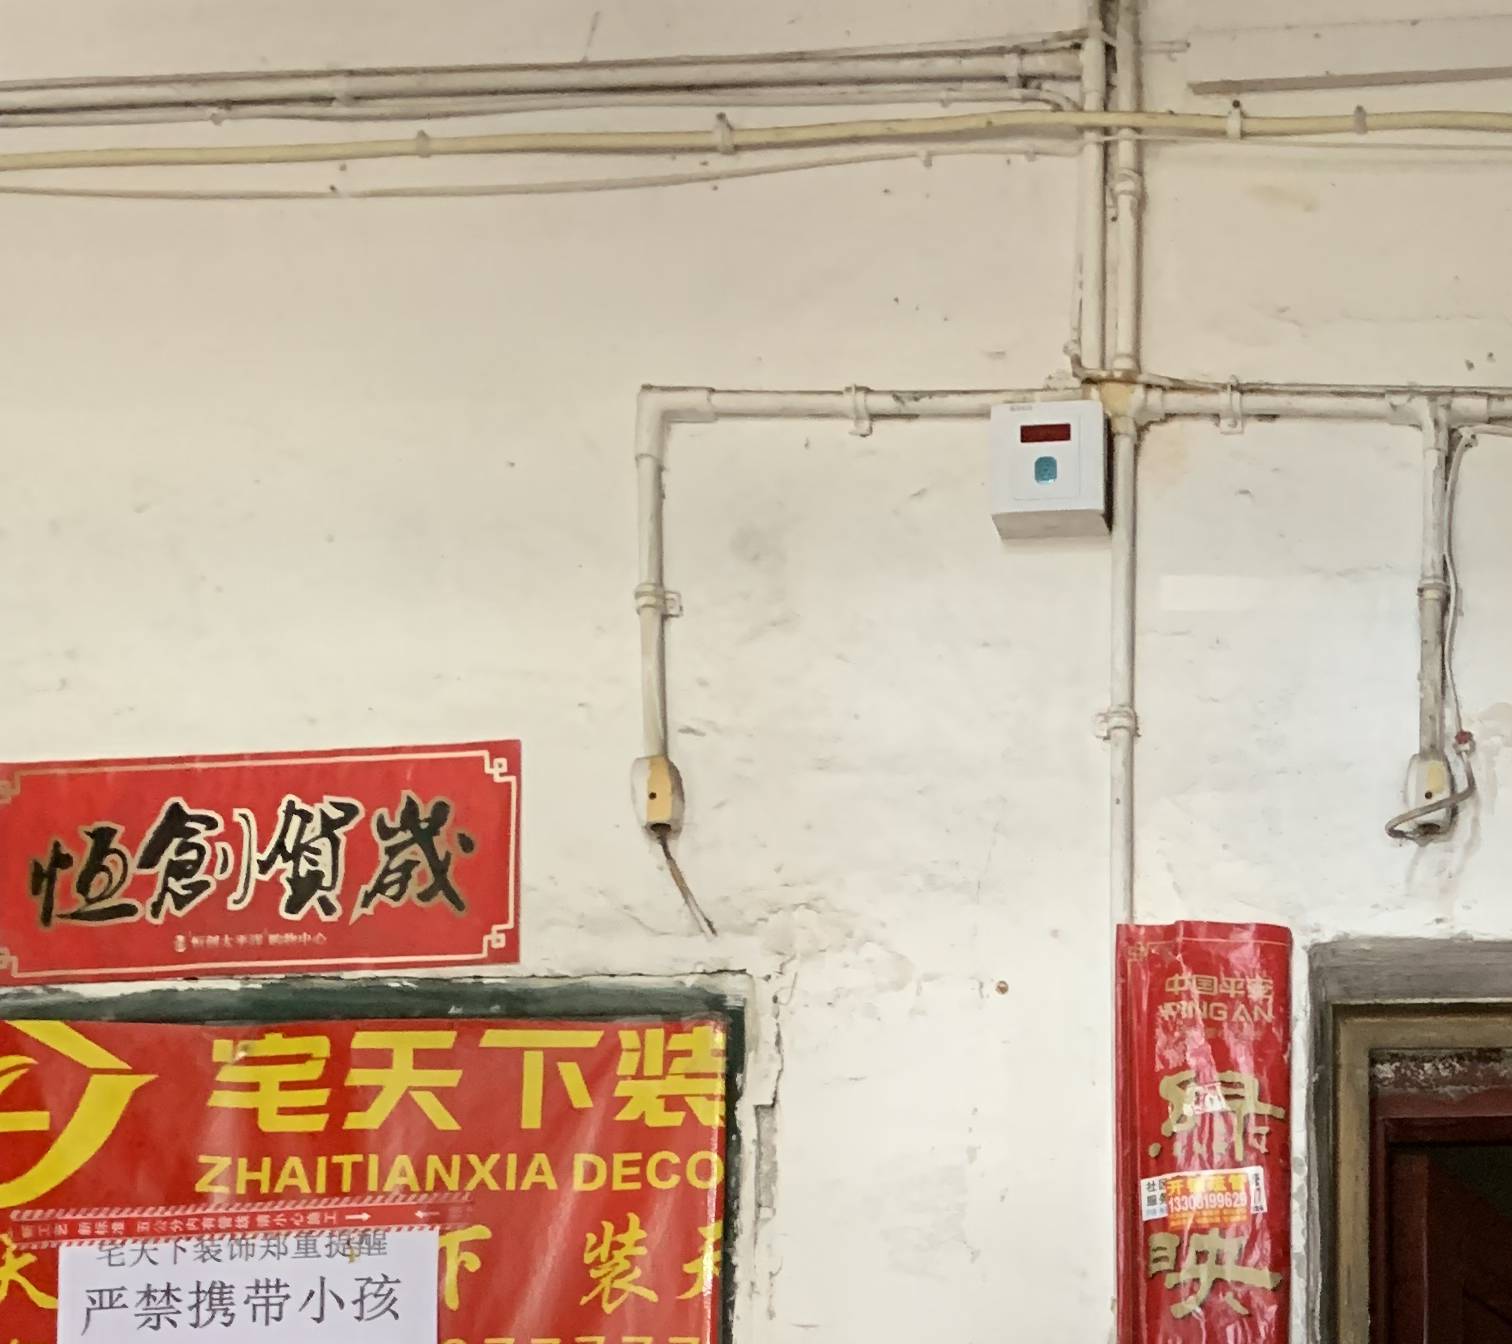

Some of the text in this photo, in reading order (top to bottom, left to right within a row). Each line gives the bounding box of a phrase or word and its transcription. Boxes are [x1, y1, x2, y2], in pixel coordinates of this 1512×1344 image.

[207, 1029, 724, 1133] 宅天下装
[195, 1151, 724, 1195] ZHAITIANXIA DECO
[80, 1273, 402, 1336] 严禁携带小孩
